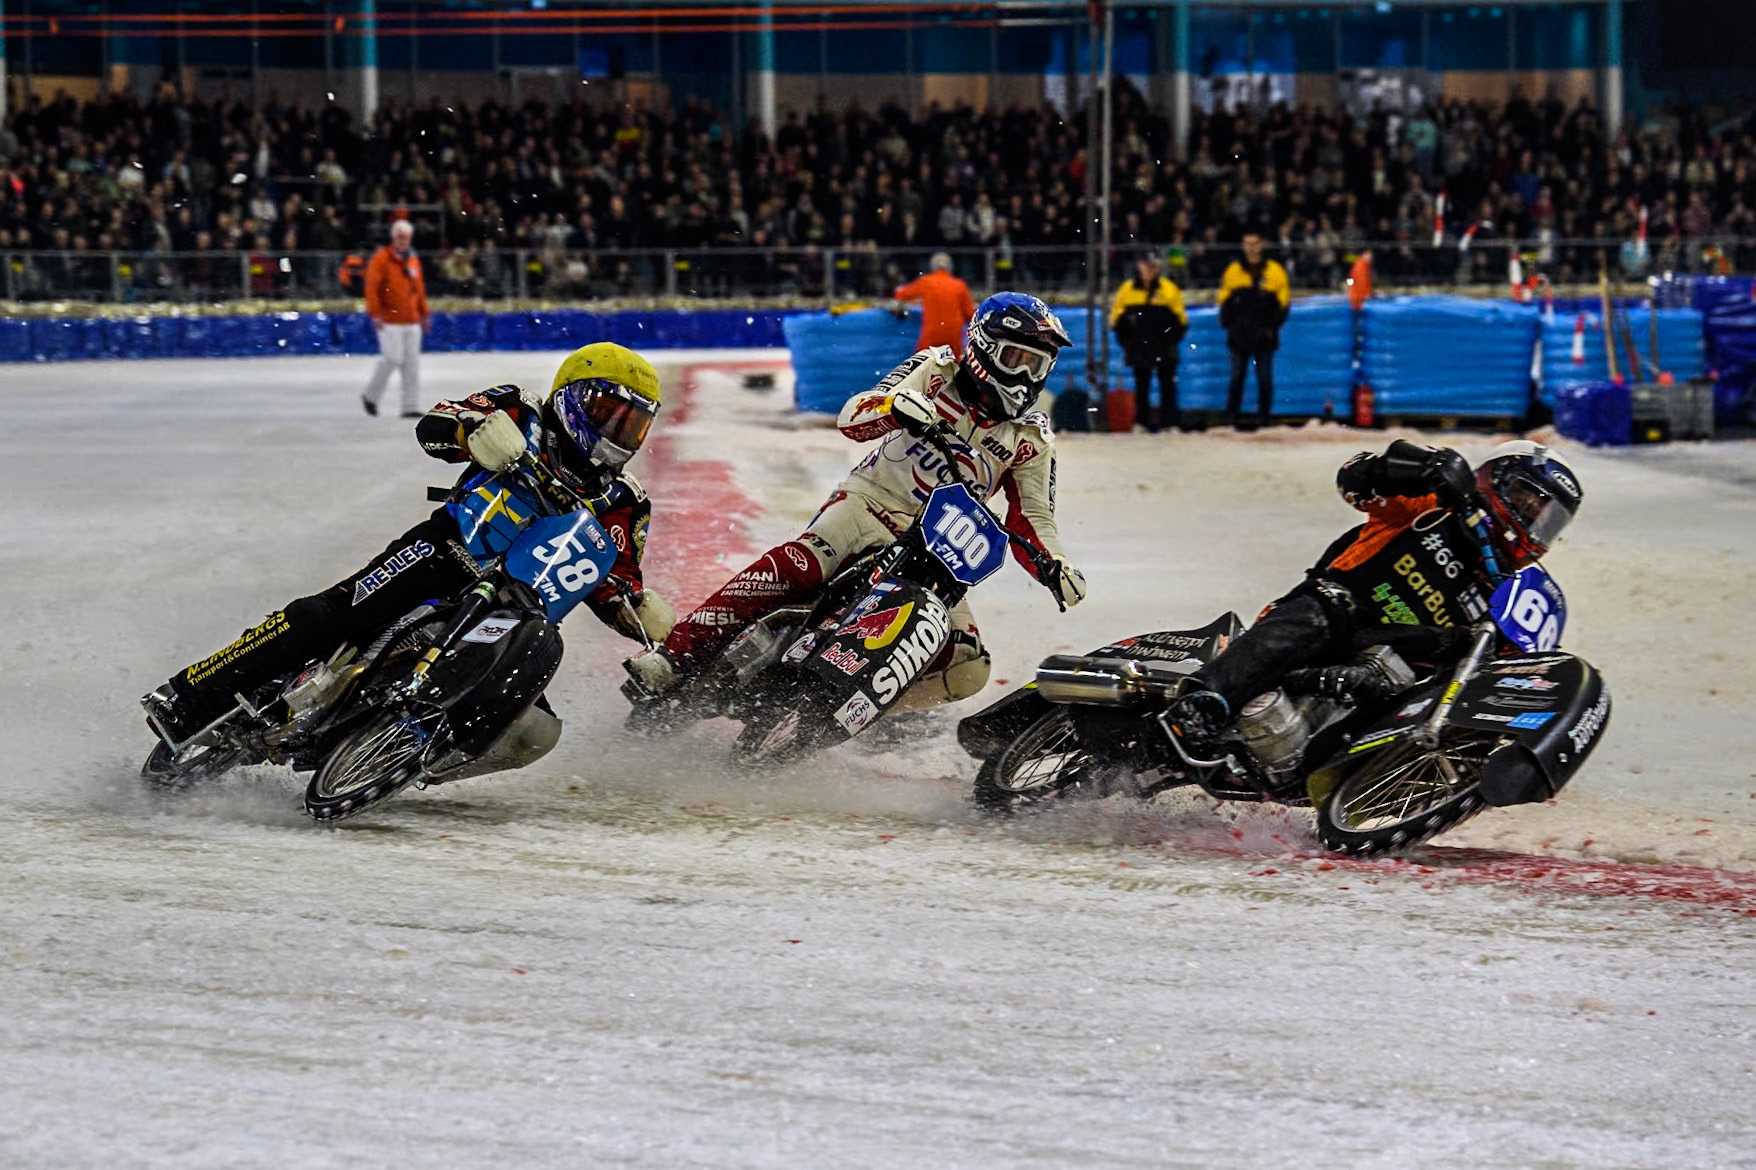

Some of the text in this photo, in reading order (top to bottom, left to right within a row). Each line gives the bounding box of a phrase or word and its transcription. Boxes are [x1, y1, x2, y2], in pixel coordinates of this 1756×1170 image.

[980, 435, 1014, 463] #100
[933, 502, 990, 570] 100
[361, 540, 435, 595] REJLERS
[532, 531, 600, 593] 58
[936, 541, 963, 570] FIM
[1421, 533, 1464, 579] #66
[838, 649, 870, 676] Bull
[844, 701, 871, 727] FUCHS
